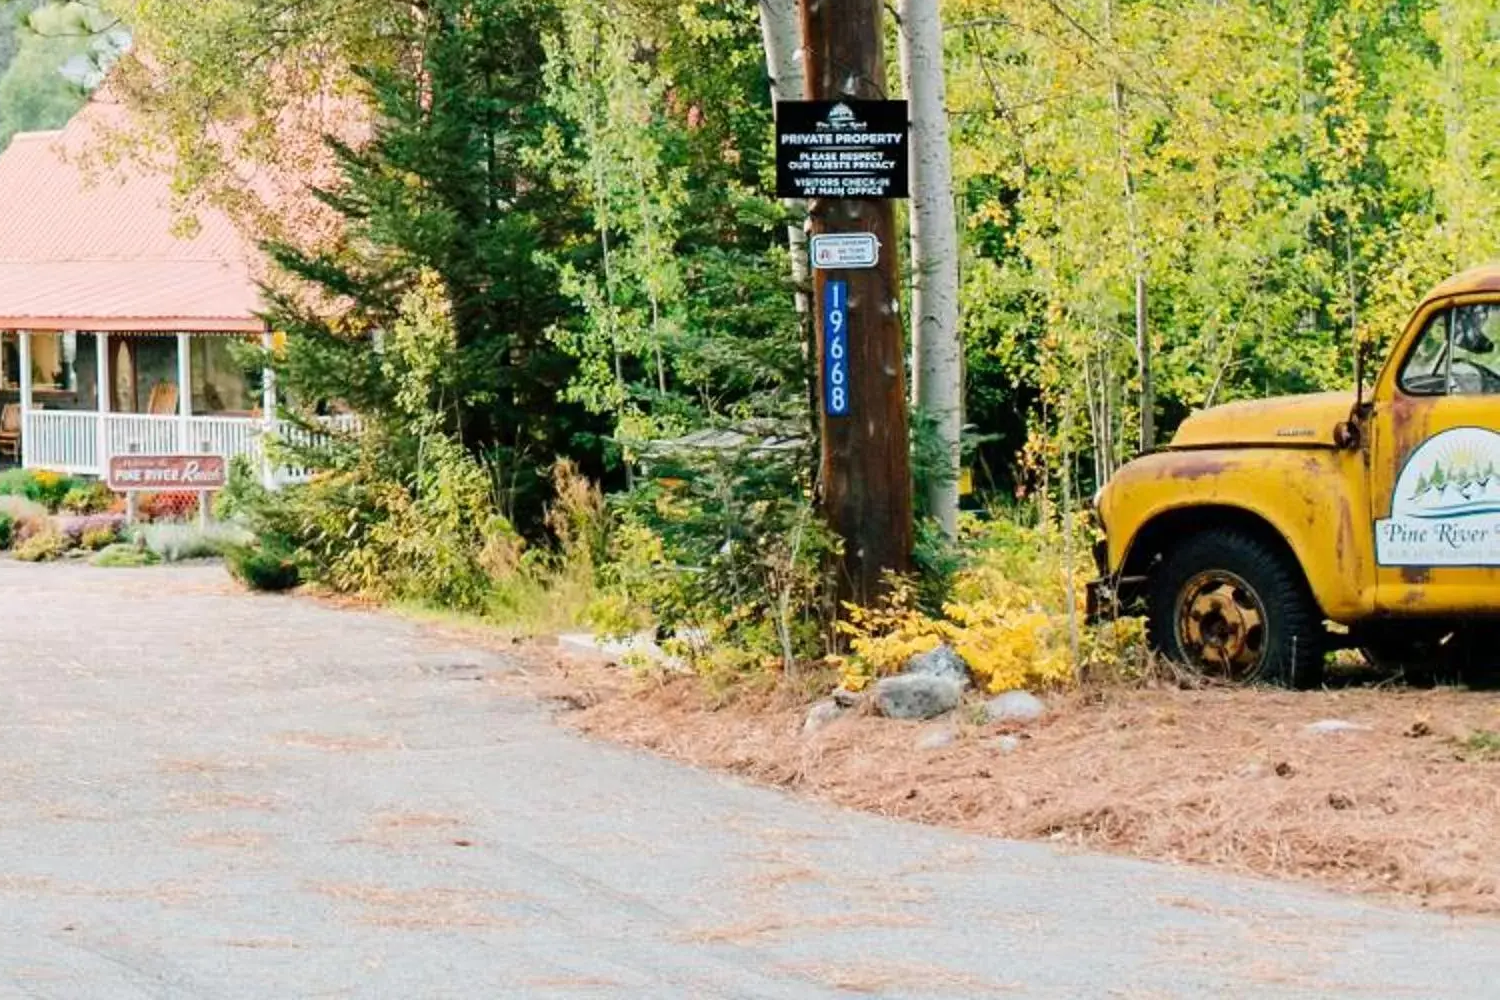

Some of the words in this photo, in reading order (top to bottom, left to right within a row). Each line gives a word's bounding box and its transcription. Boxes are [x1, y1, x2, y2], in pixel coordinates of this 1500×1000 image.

[781, 133, 833, 145] PRIVATE
[835, 133, 902, 144] PROPERTY
[799, 152, 837, 161] PLEASE
[839, 152, 884, 161] RESPECT
[787, 161, 811, 170] OUR
[853, 161, 896, 169] PRIVACY
[794, 178, 840, 187] VISITORS
[803, 187, 816, 195] AT
[817, 187, 845, 196] MAIN
[846, 187, 883, 195] OFFICE
[829, 284, 845, 412] 19668
[1384, 523, 1428, 543] Pine
[1434, 523, 1489, 549] River
